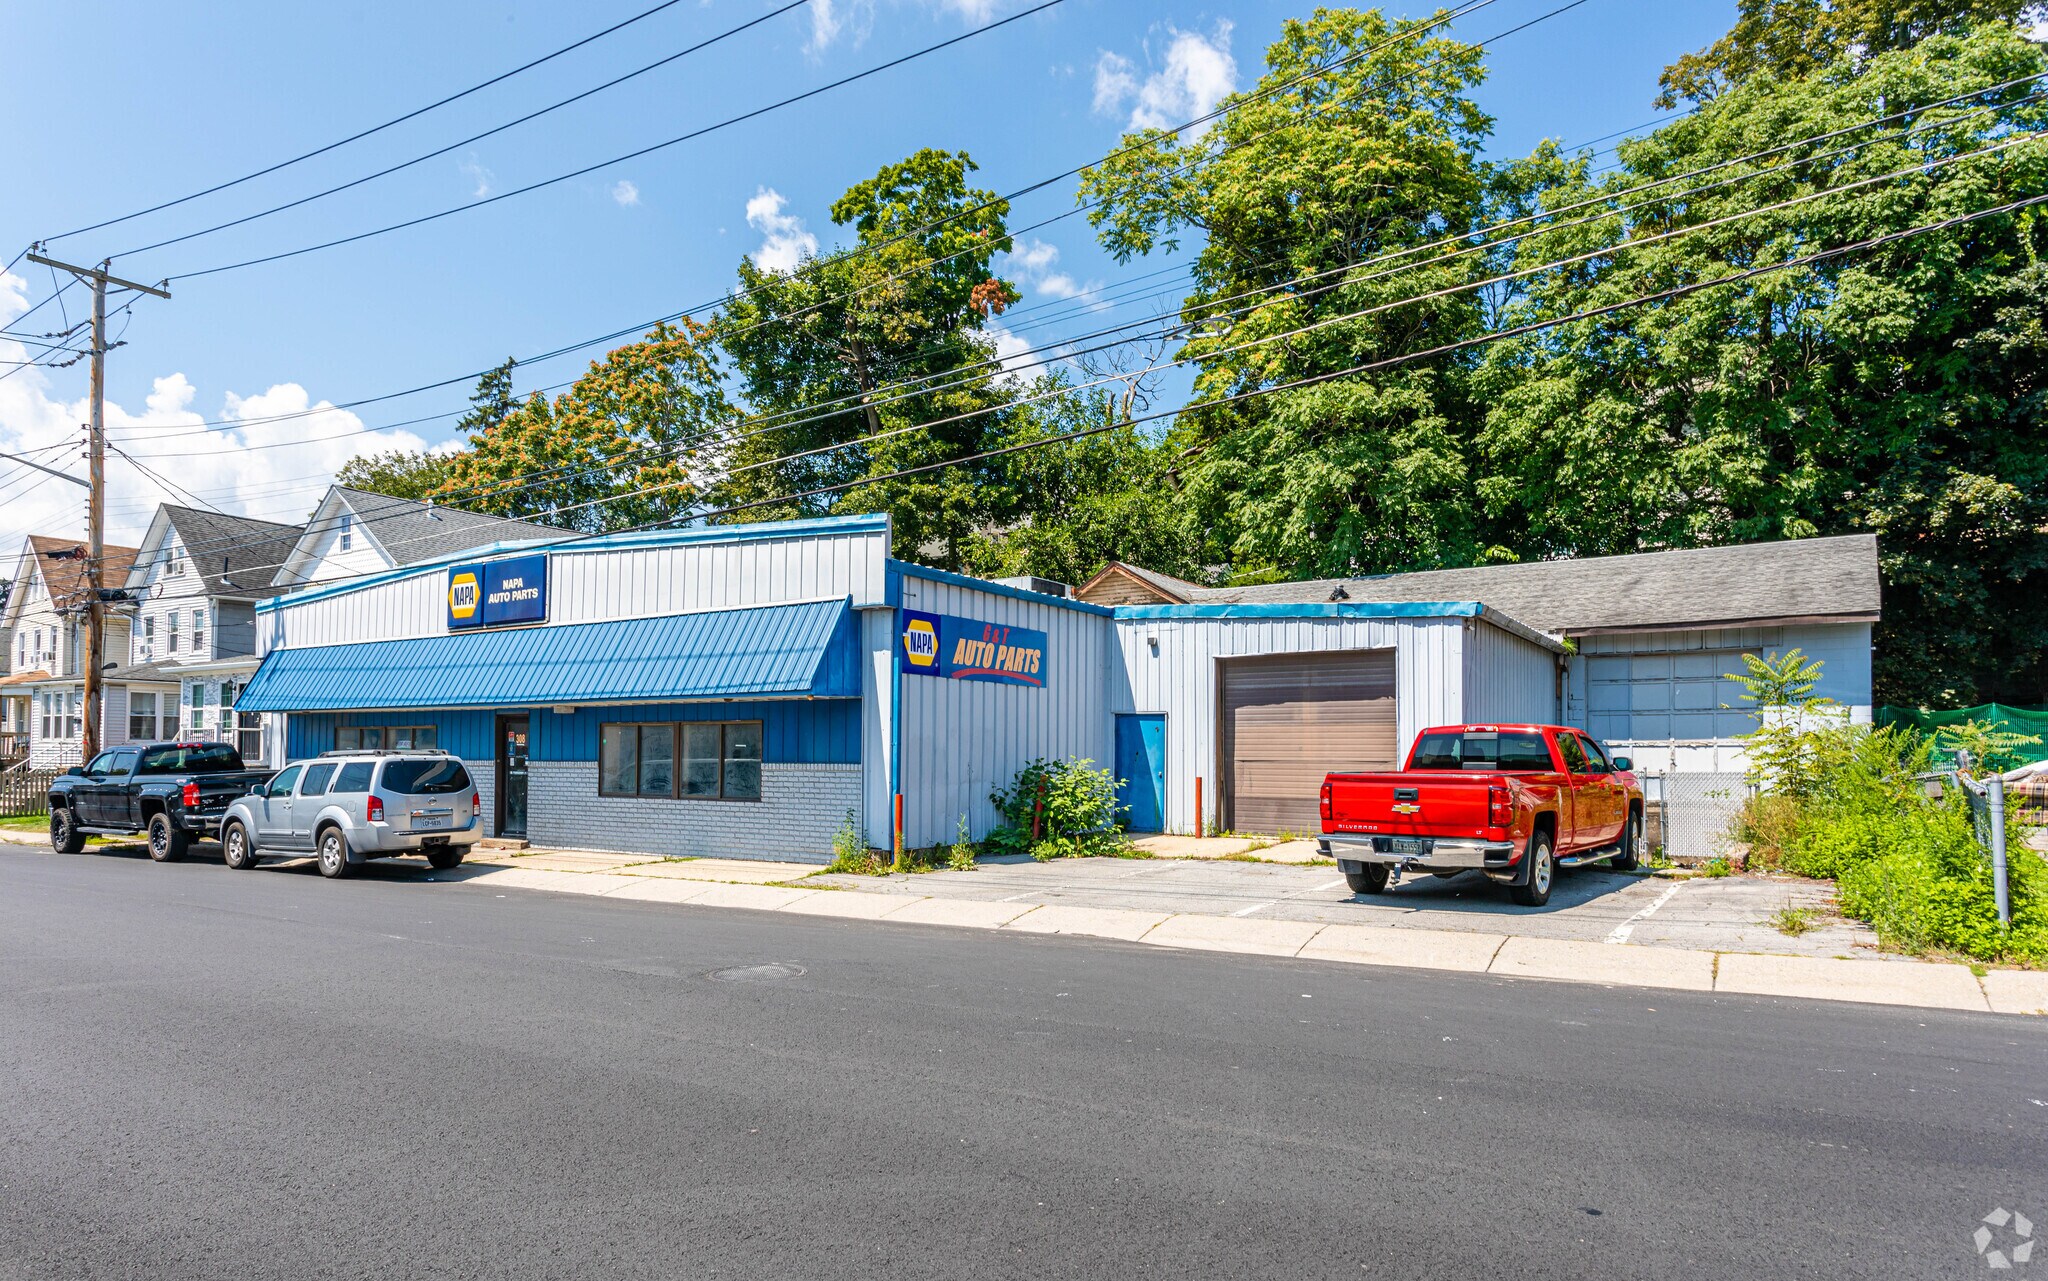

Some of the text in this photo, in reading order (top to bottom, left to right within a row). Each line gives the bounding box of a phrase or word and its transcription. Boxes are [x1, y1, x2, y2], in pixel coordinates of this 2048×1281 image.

[503, 578, 523, 590] NAPA
[453, 586, 474, 606] NAPA
[488, 588, 539, 604] AUTO PARTS
[910, 631, 933, 655] NAPA
[992, 630, 1000, 643] &
[1002, 628, 1010, 645] T
[952, 638, 1041, 674] AUTO PARTS
[1338, 823, 1378, 831] SILVERADO
